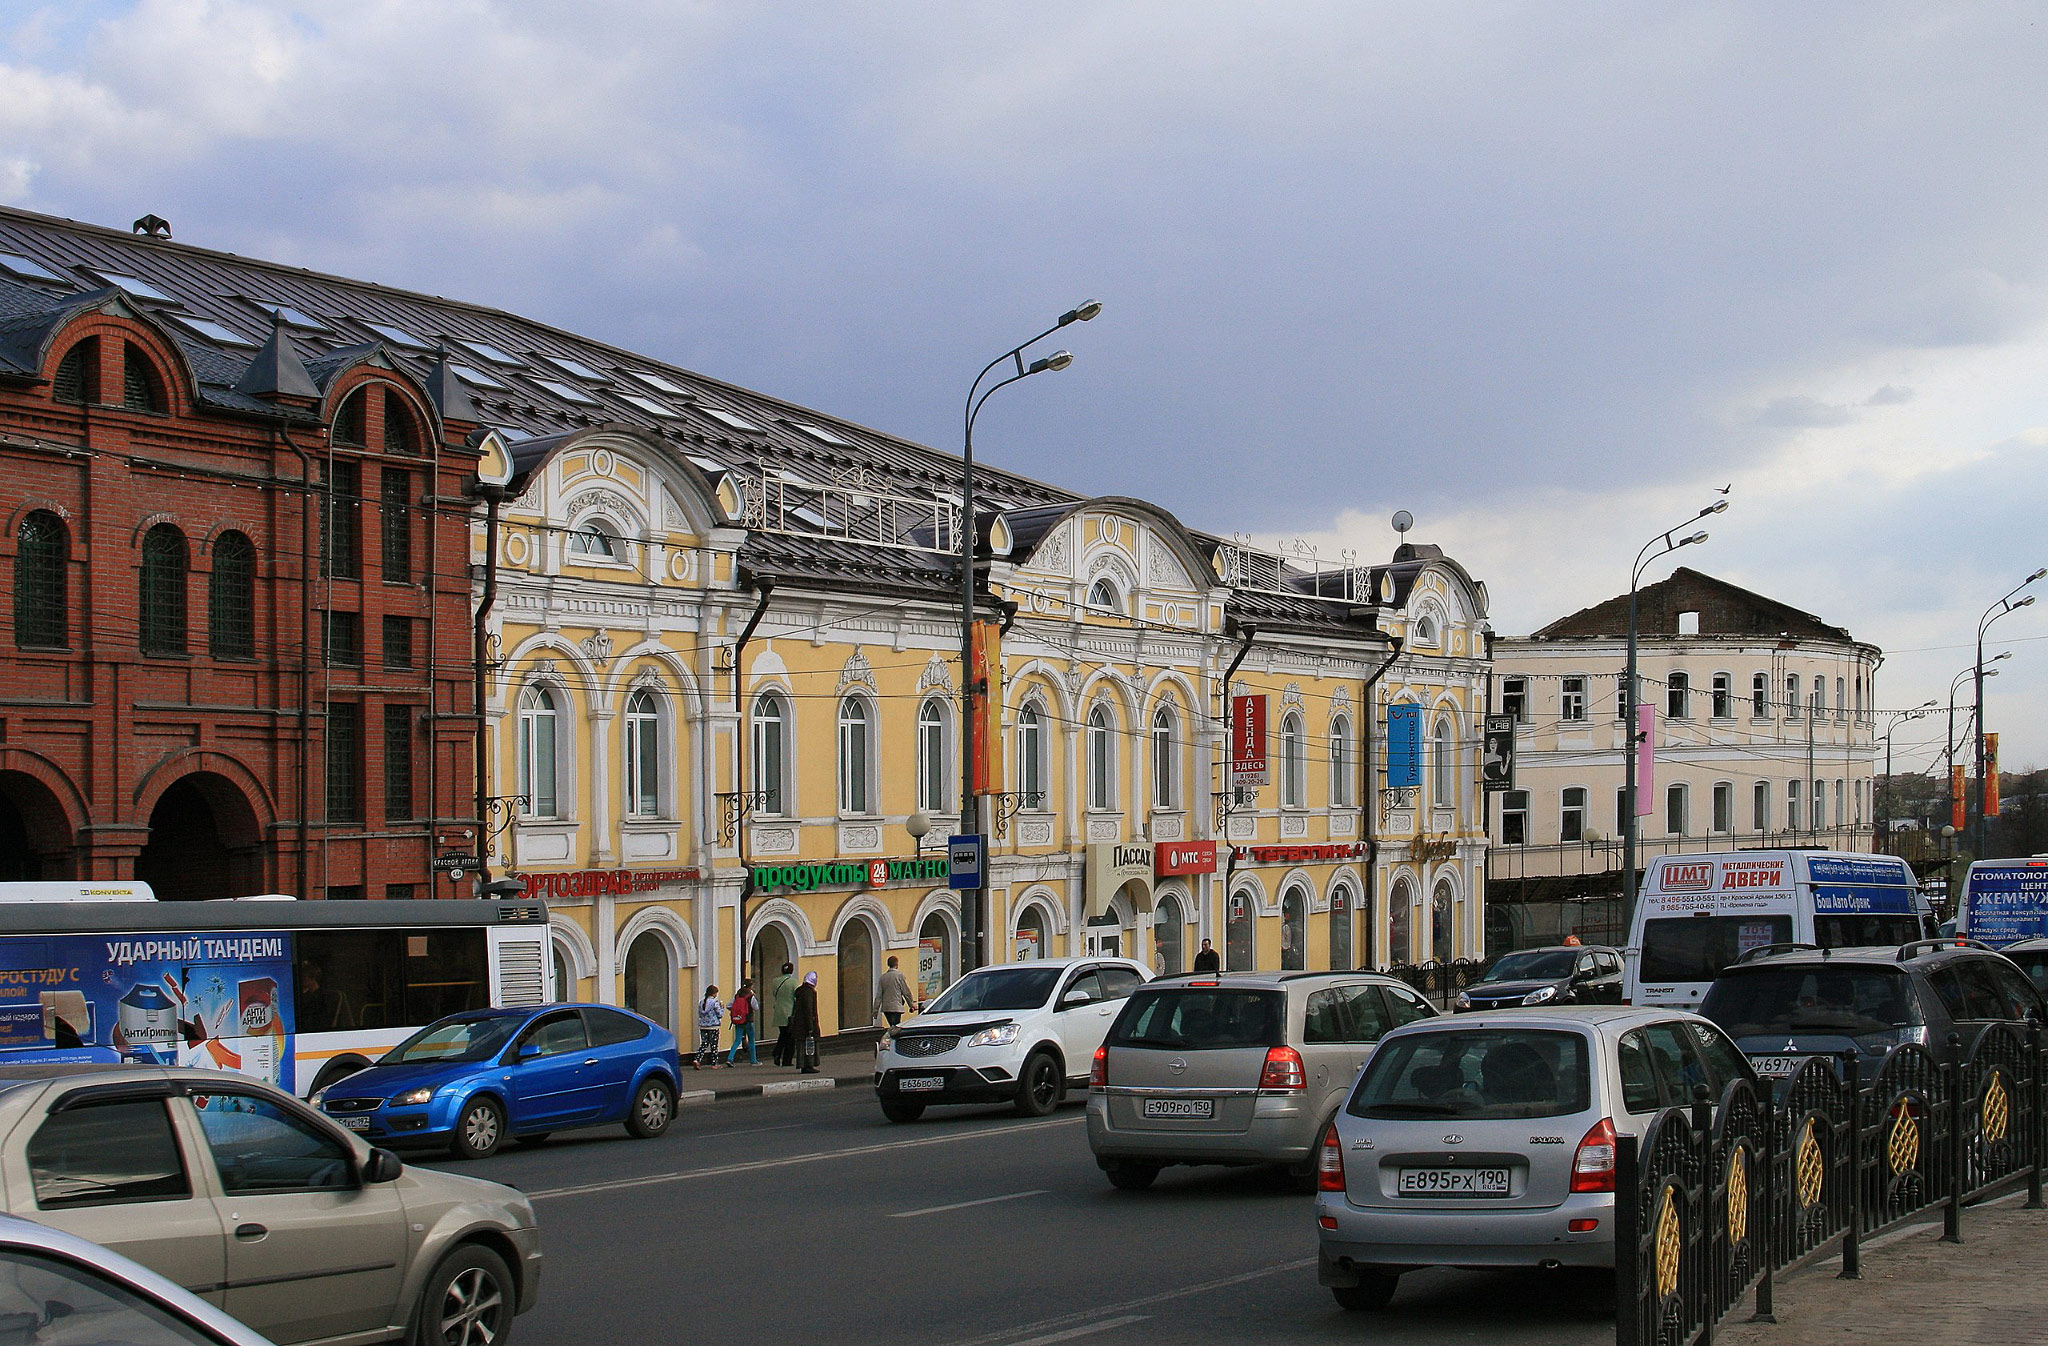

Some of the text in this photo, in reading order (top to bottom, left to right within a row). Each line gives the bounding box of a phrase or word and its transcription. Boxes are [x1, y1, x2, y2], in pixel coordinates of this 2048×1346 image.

[1245, 697, 1255, 759] АРЕНДА
[1488, 723, 1510, 731] LAB
[1407, 720, 1417, 783] Турагентство
[1235, 762, 1264, 771] ЗДЕСЬ
[1181, 852, 1198, 863] МТС
[1722, 861, 1784, 870] МЕТАЛЛИЧЕСКИЕ
[753, 864, 869, 892] продукты
[873, 863, 886, 878] 24
[1722, 871, 1781, 889] ДВЕРИ
[1816, 893, 1832, 909] Бош
[1832, 893, 1849, 909] Авто
[106, 936, 283, 966] УДАРНЫЙ ТАНДЕМ!
[919, 957, 933, 972] 199
[69, 967, 80, 981] С
[246, 1008, 266, 1017] АНТИ
[242, 1016, 266, 1026] АНГИН
[1148, 1102, 1209, 1113] Е909РО 150
[1530, 1136, 1565, 1144] KALINA
[1405, 1170, 1504, 1190] Е895РХ 190
